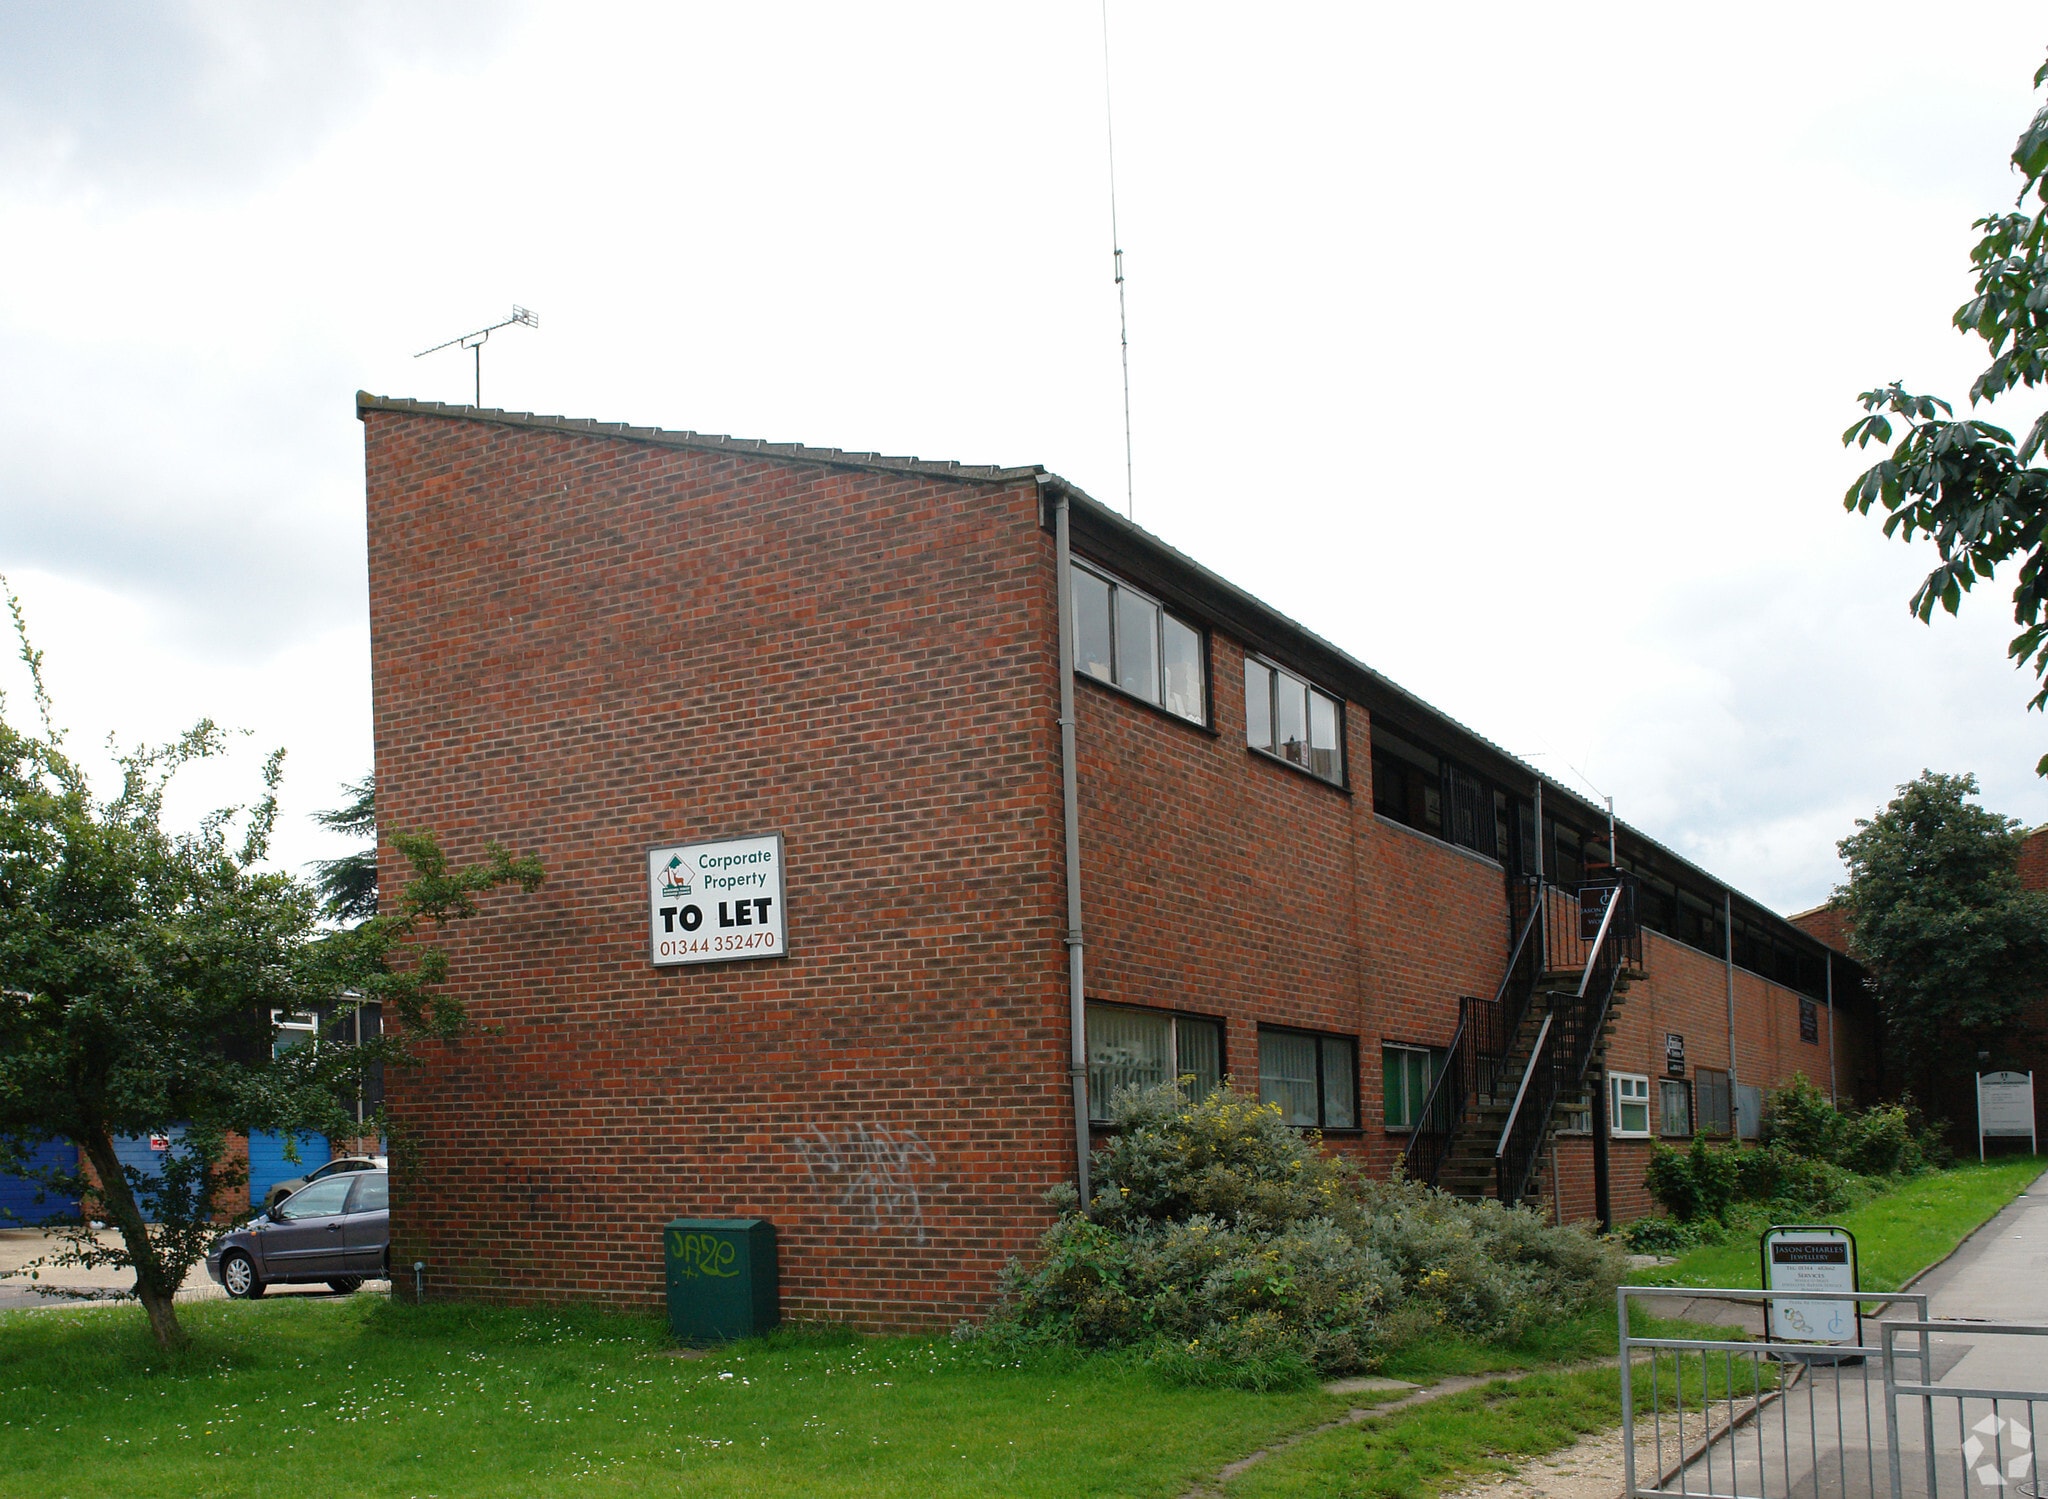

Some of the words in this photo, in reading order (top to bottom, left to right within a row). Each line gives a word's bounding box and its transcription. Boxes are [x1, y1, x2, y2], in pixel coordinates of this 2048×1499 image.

[699, 850, 772, 870] Corporate
[704, 872, 766, 891] Property
[660, 904, 703, 933] TO
[718, 897, 772, 928] LET
[660, 938, 709, 956] 01344
[714, 932, 775, 952] 352470
[1775, 1245, 1802, 1253] JASON
[1804, 1245, 1843, 1253] CHARLES
